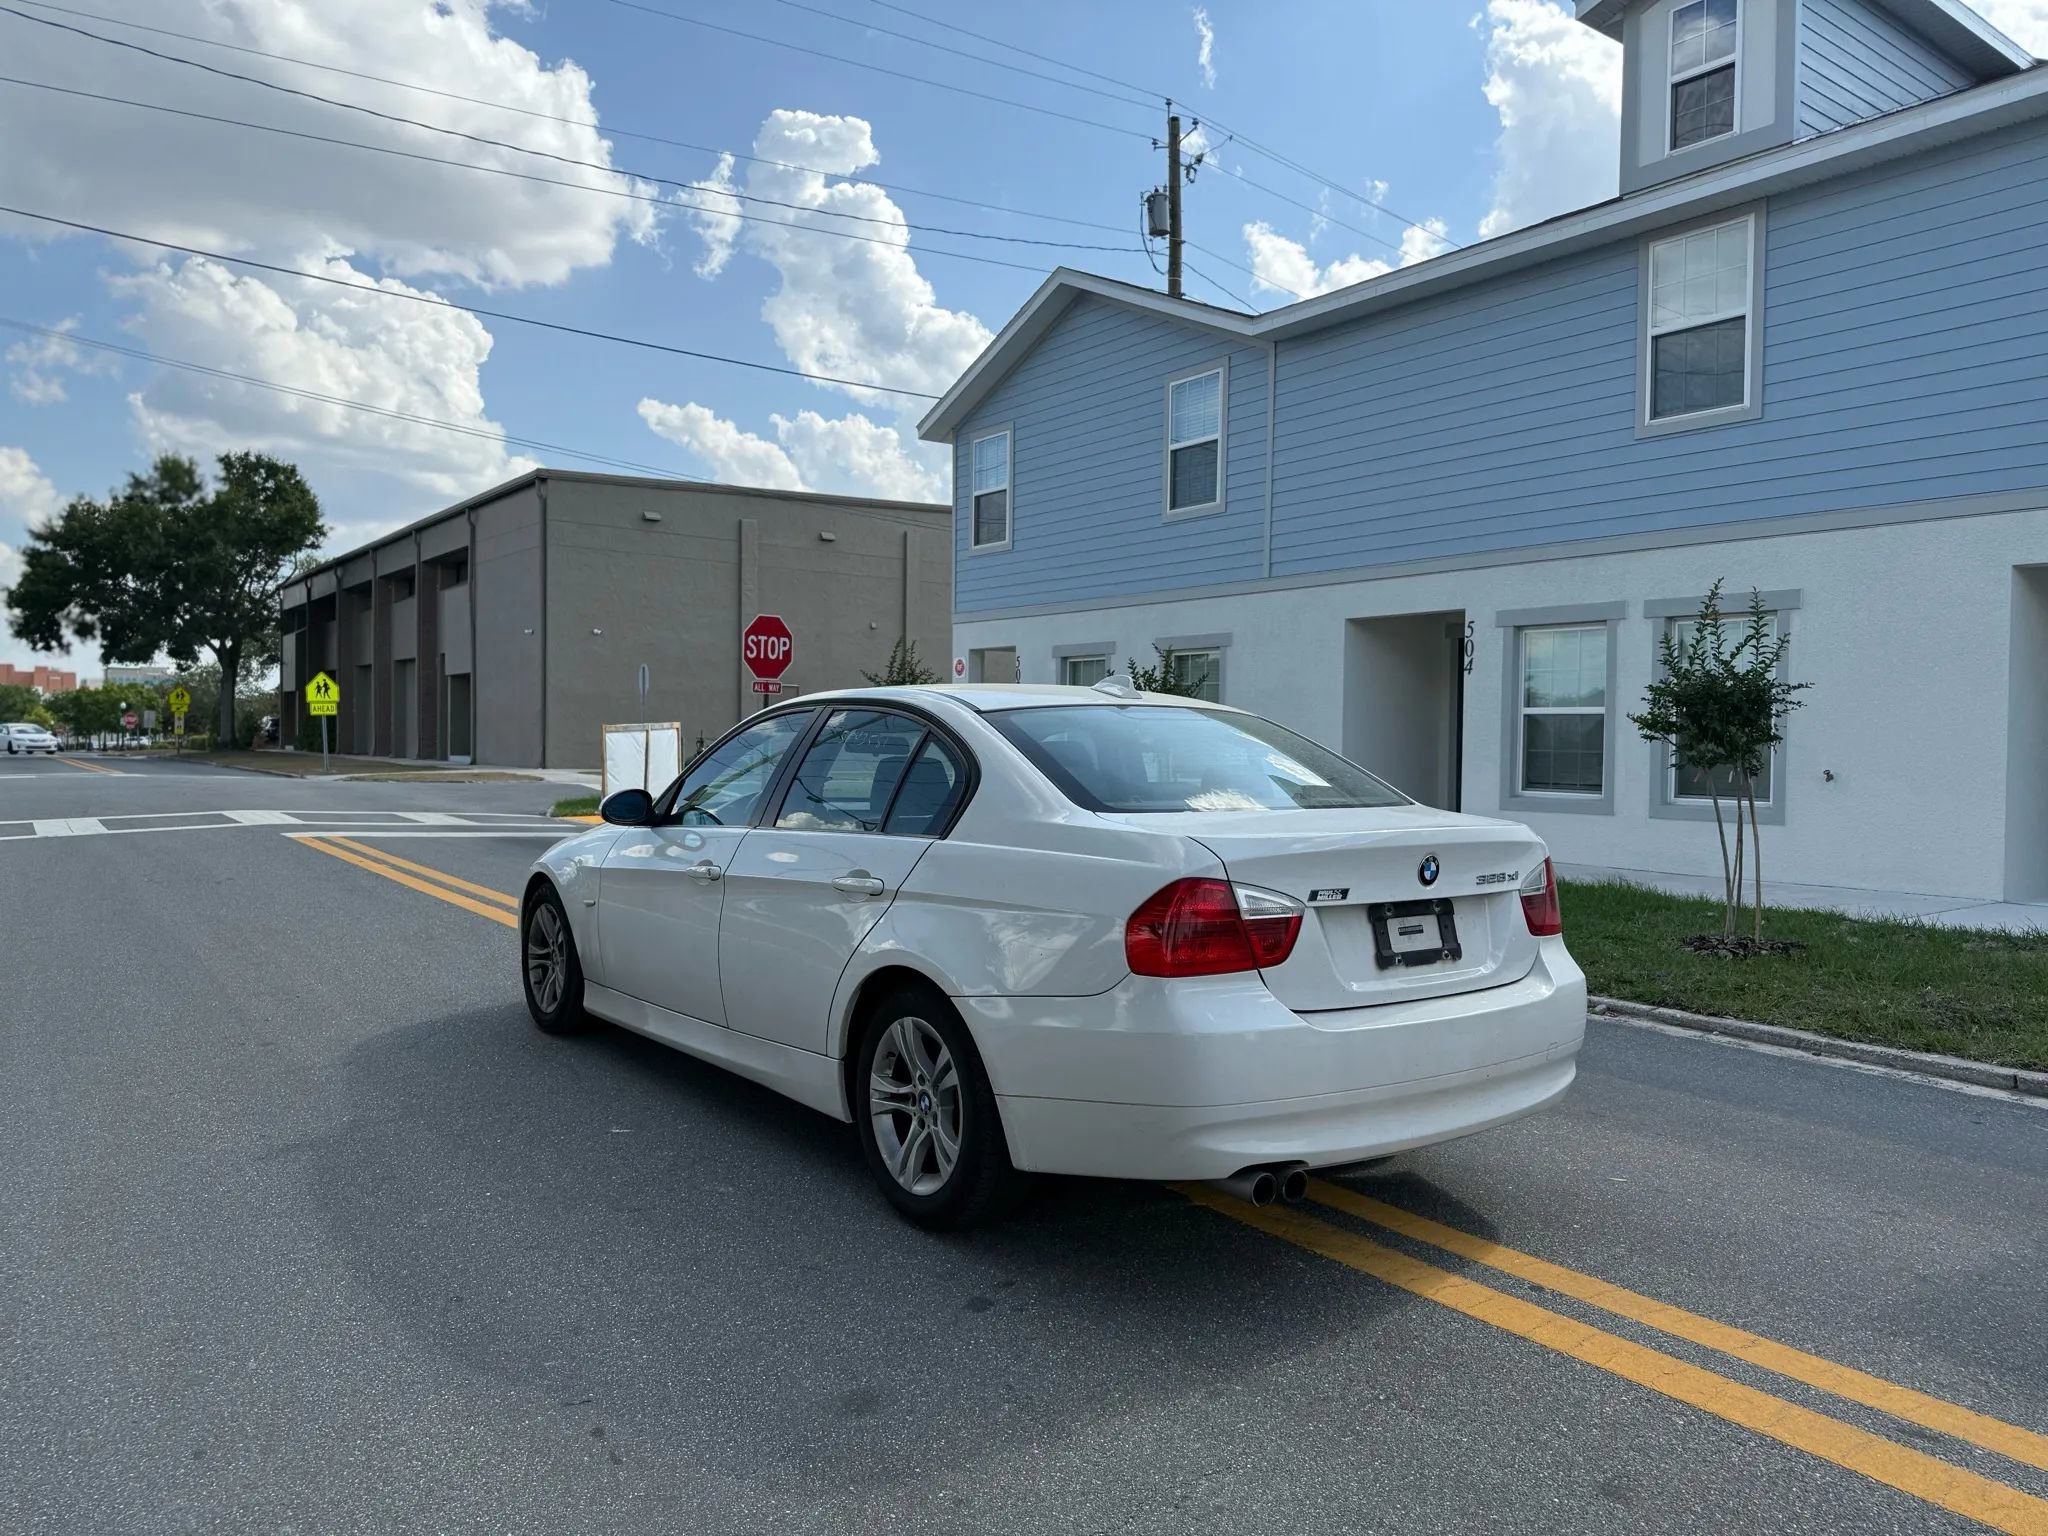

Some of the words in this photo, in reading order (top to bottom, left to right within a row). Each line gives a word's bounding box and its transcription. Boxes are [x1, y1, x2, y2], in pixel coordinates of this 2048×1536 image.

[746, 635, 790, 660] STOP
[1464, 620, 1475, 675] 504
[754, 682, 765, 692] ALL
[768, 684, 780, 692] WAY
[312, 704, 336, 713] AHEAD
